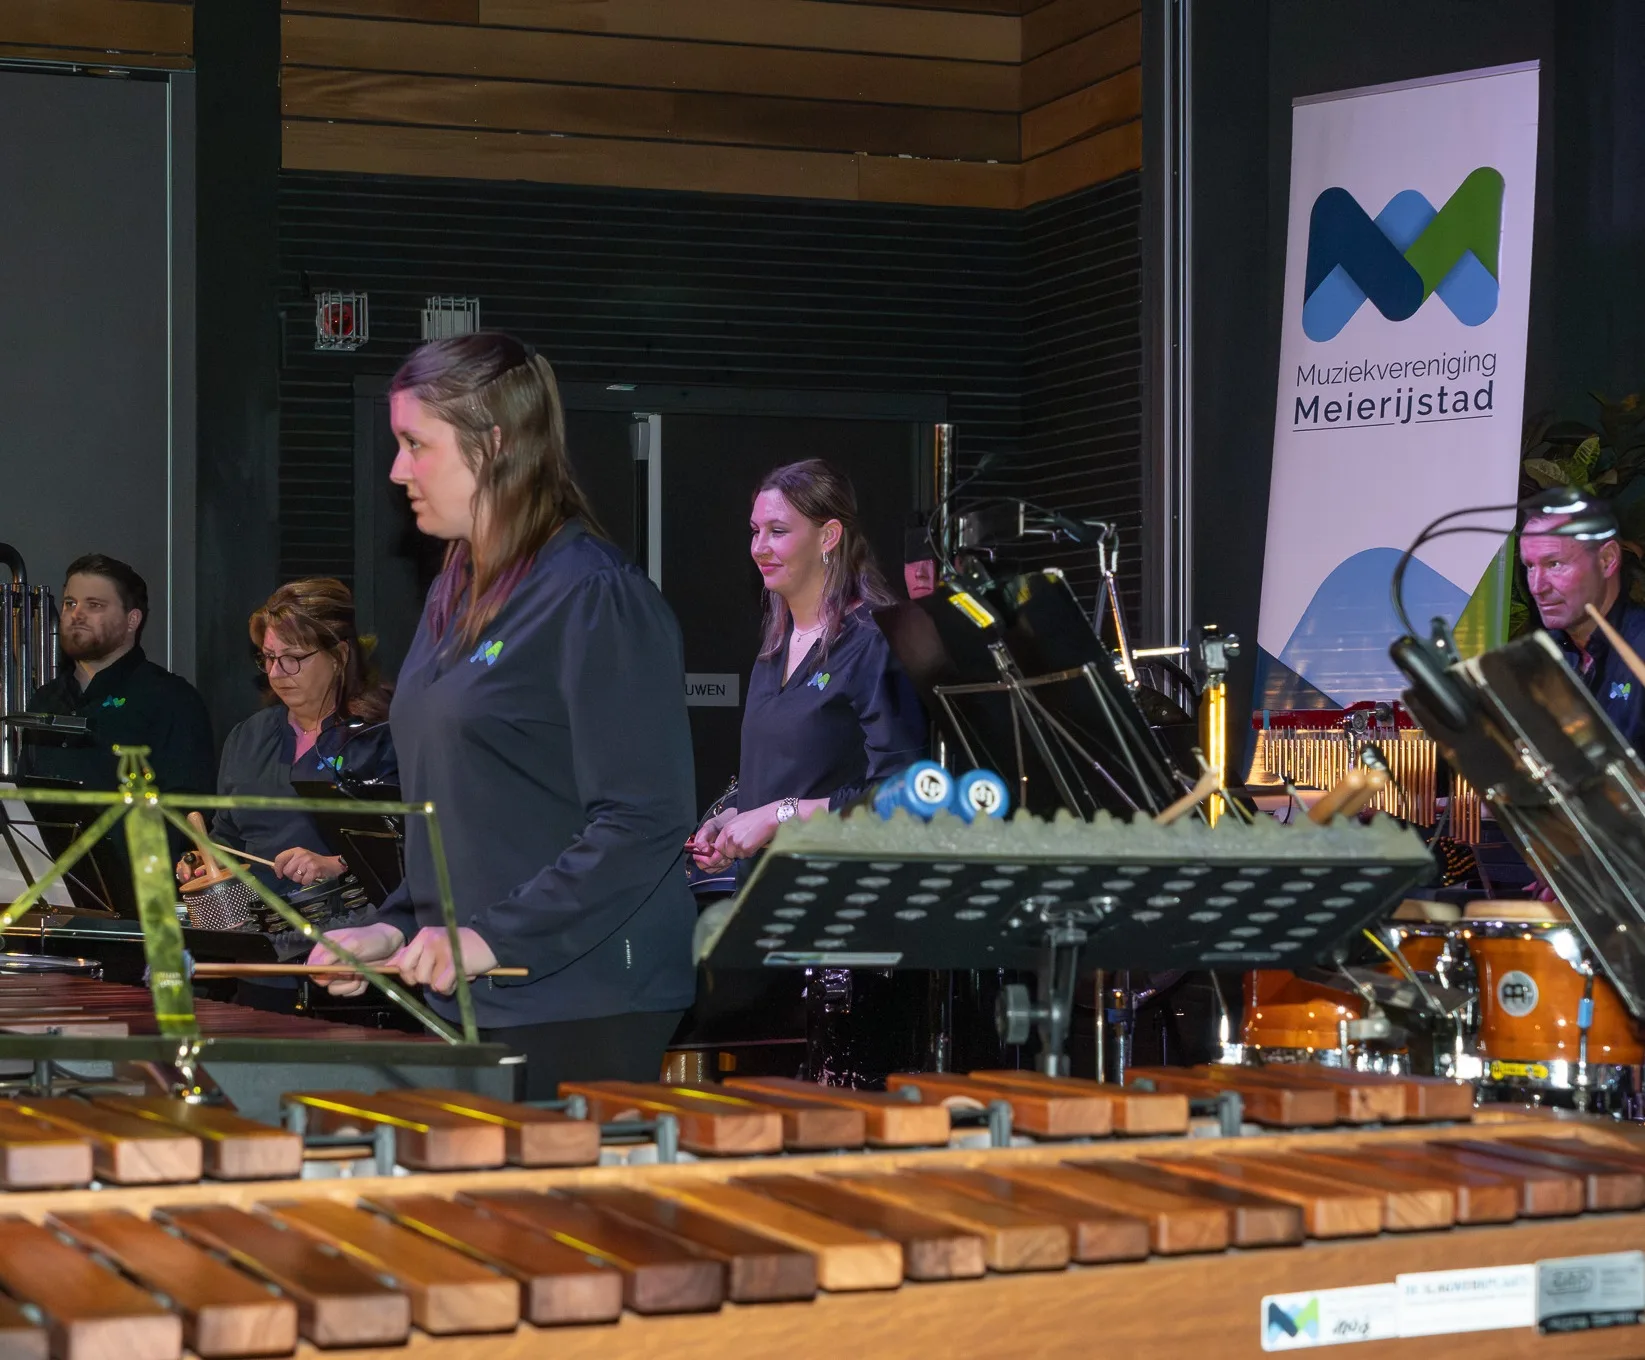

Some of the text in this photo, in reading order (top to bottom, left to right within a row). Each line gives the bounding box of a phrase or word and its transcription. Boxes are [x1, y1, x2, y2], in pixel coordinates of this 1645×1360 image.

[1296, 350, 1497, 387] Muziekvereniging
[1294, 379, 1494, 424] Meierijstad
[684, 683, 726, 697] UWEN
